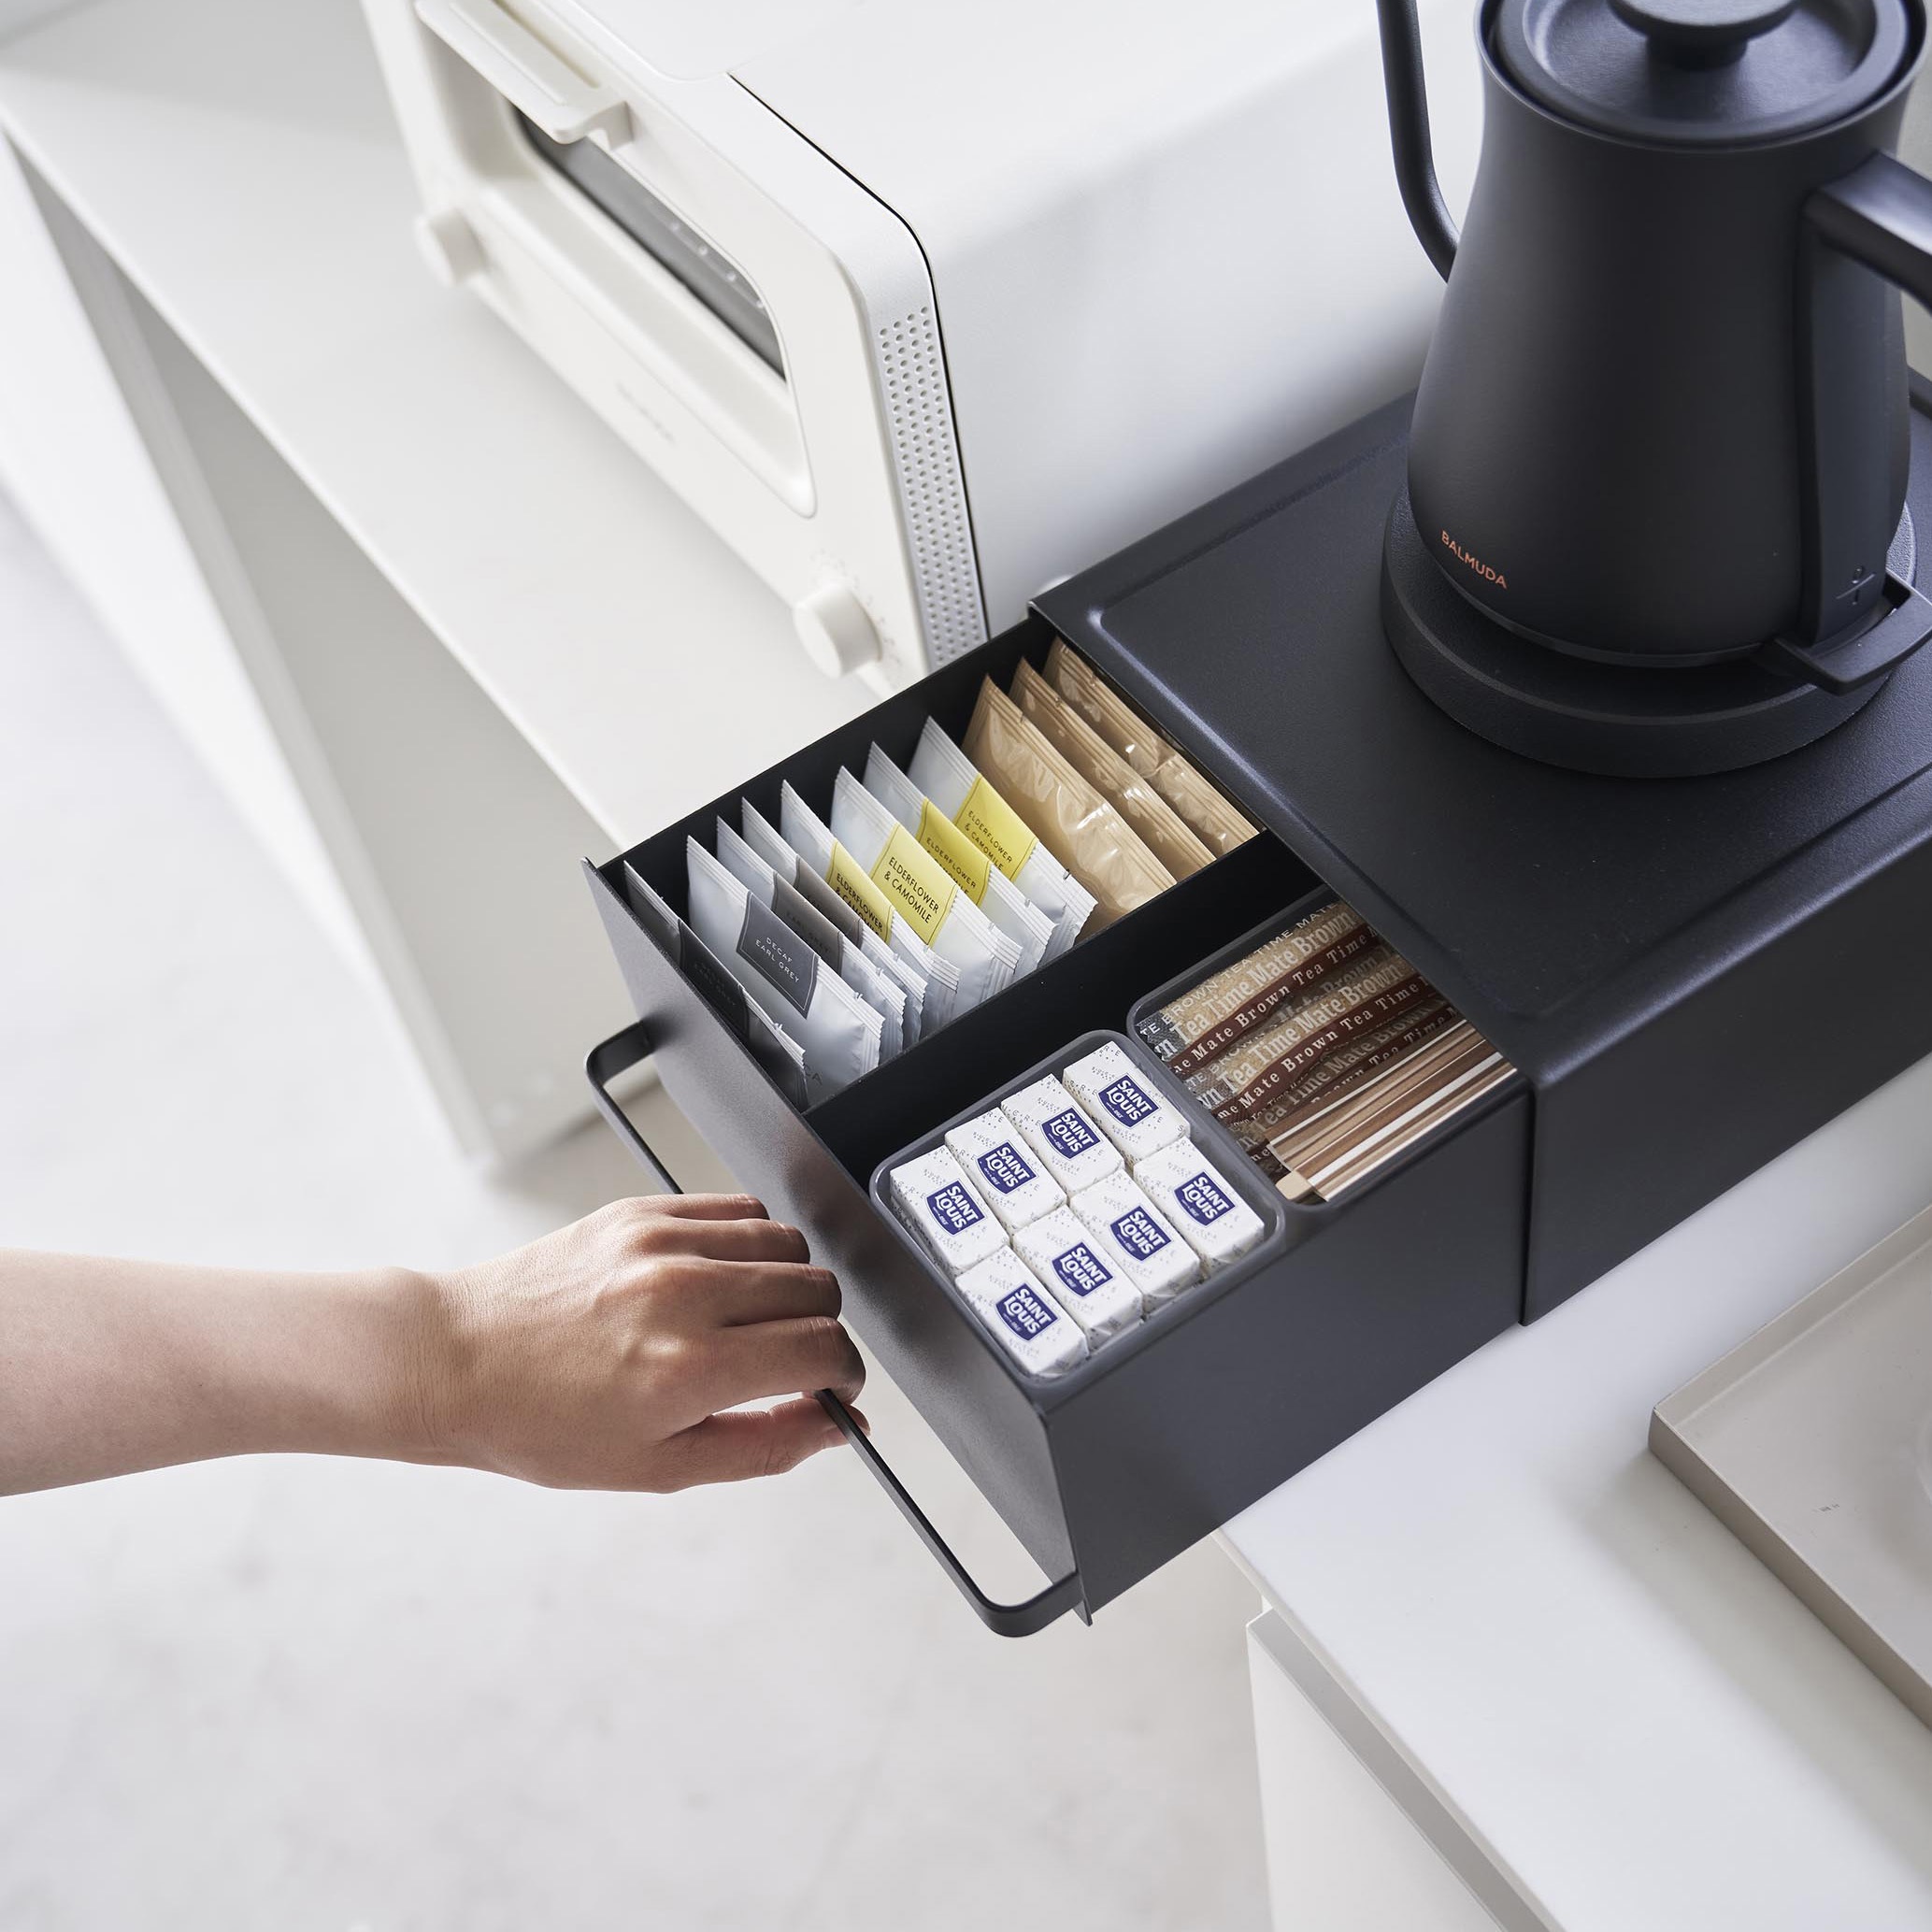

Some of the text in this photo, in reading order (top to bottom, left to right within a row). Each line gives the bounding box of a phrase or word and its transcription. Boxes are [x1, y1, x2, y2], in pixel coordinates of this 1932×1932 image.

[1442, 530, 1507, 589] BALMUDA
[968, 810, 1012, 863] ELDERFLOWER
[926, 837, 977, 889] ELDERFLOWER
[836, 873, 883, 933] ELDERFLOWER
[883, 870, 932, 923] & CAMOMILE
[889, 856, 939, 914] ELDERFLOWER
[755, 939, 799, 983] EARL GREY
[766, 937, 793, 964] DECAF
[1161, 980, 1219, 1025] BROWN
[1221, 958, 1252, 979] TEA
[1169, 1013, 1209, 1045] Tea
[1202, 981, 1254, 1021] Time
[1246, 950, 1298, 987] Mate
[1291, 911, 1357, 957] Brown
[1191, 1027, 1234, 1061] Mate
[1235, 985, 1291, 1027] Brown
[1292, 964, 1324, 986] Tea
[1326, 936, 1367, 965] Time
[1216, 1063, 1257, 1094] Tea
[1248, 1028, 1301, 1066] Time
[1294, 997, 1346, 1034] Mate
[1338, 964, 1404, 1006] Brown
[1238, 1072, 1280, 1109] Mate
[1281, 1031, 1338, 1072] Brown
[1339, 1009, 1373, 1031] Tea
[1375, 983, 1419, 1010] Time
[1107, 1086, 1141, 1121] LOUIS
[1117, 1080, 1152, 1112] SAINT
[1050, 1119, 1082, 1152] LOUIS
[1061, 1112, 1095, 1146] SAINT
[985, 1153, 1019, 1187] LOUIS
[997, 1147, 1030, 1180] SAINT
[935, 1193, 966, 1228] LOUIS
[947, 1185, 979, 1222] SAINT
[1182, 1183, 1218, 1219] LOUIS
[1194, 1177, 1229, 1211] SAINT
[1118, 1218, 1153, 1254] LOUIS
[1129, 1210, 1166, 1246] SAINT
[1060, 1254, 1095, 1290] LOUIS
[1071, 1247, 1107, 1282] SAINT
[1004, 1295, 1039, 1334] LOUIS
[1015, 1288, 1052, 1324] SAINT
